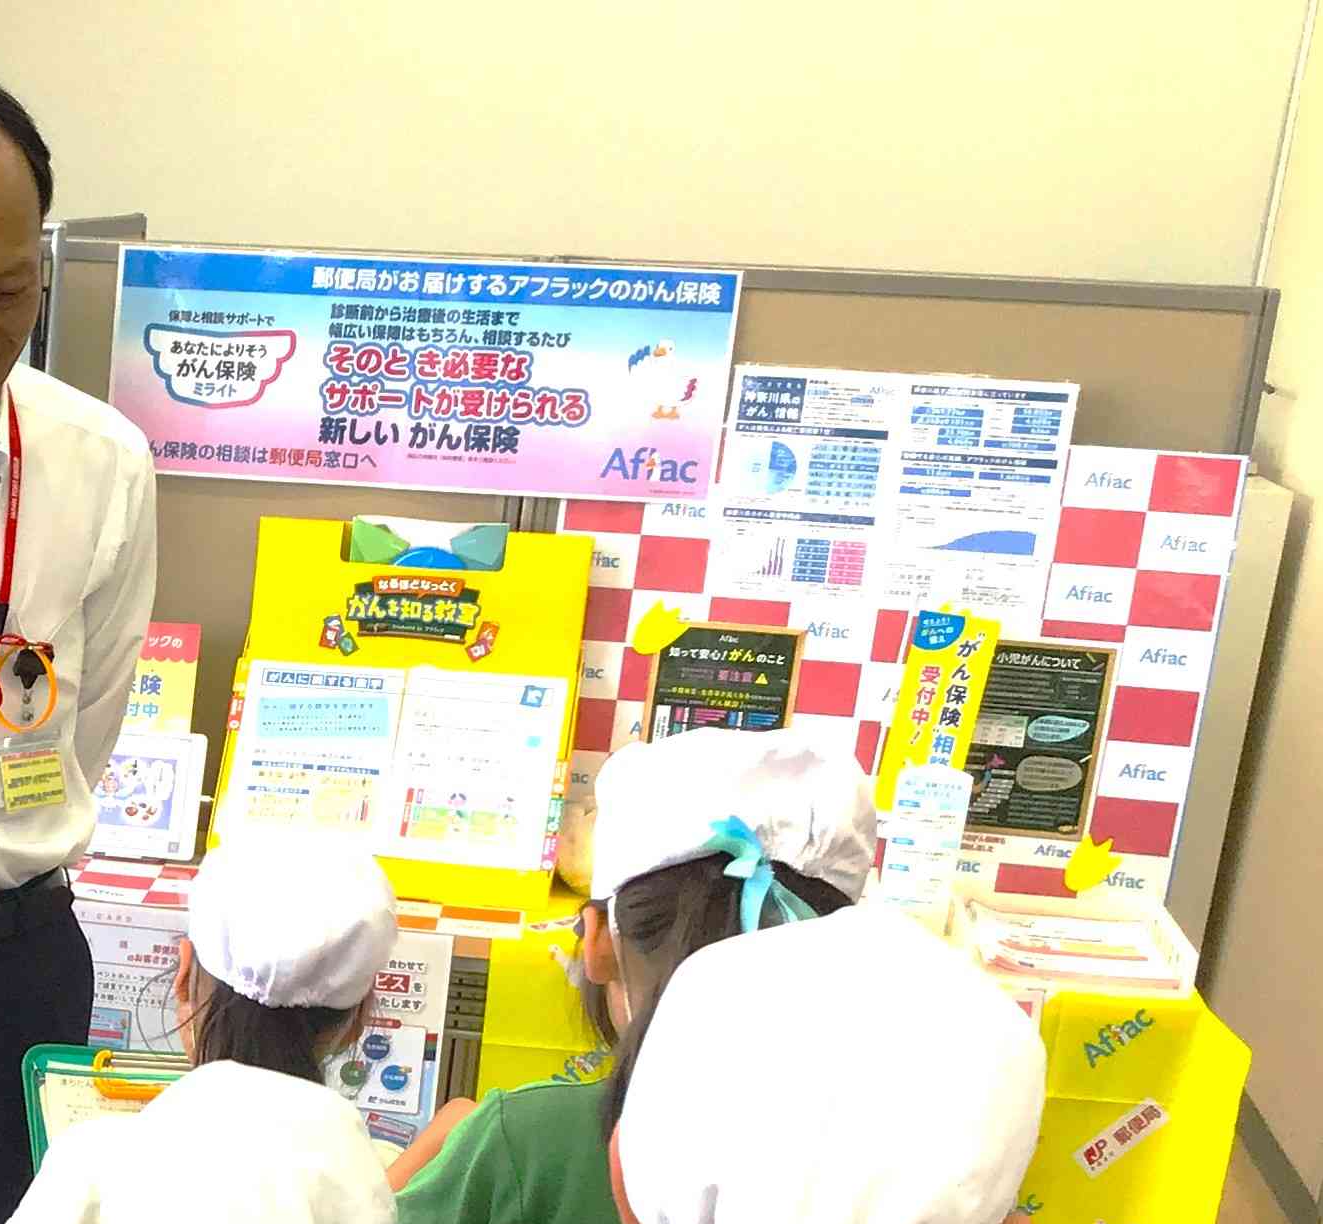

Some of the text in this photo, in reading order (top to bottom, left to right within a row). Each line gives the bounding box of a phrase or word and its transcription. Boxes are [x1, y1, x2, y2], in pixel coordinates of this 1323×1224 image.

[311, 265, 722, 306] 郵便局がお届けするアフラックのがん保険
[168, 310, 276, 327] 保障と相談サポートで
[330, 303, 521, 327] 診断前から治療後の生活まで
[328, 323, 572, 348] 幅広い保障はもちろん、相談するたび
[170, 340, 268, 358] あなたによりそう
[176, 359, 258, 382] がん保険
[326, 345, 529, 382] そのとき必要な
[192, 382, 238, 398] ミライト
[324, 382, 588, 422] サポートが受けられる
[317, 417, 523, 456] 新しいがん保険
[601, 446, 699, 485] Aflac
[1084, 471, 1133, 491] Aflac
[1160, 534, 1208, 554] Aflac
[377, 578, 458, 593] なるほどなっとく
[1065, 585, 1113, 605] Aflac
[348, 591, 480, 627] がんを知る教室
[806, 621, 851, 640] Aflac
[668, 647, 786, 665] 知って安心!がんのこと
[995, 652, 1082, 670] 小児がんについて
[1140, 648, 1188, 668] Aflac
[909, 665, 941, 745] 受付中!
[1119, 763, 1166, 783] Aflac
[388, 959, 426, 972] 合わせて
[379, 997, 422, 1011] たします
[1083, 1008, 1155, 1069] Aflac
[1112, 1104, 1162, 1146] 郵便局
